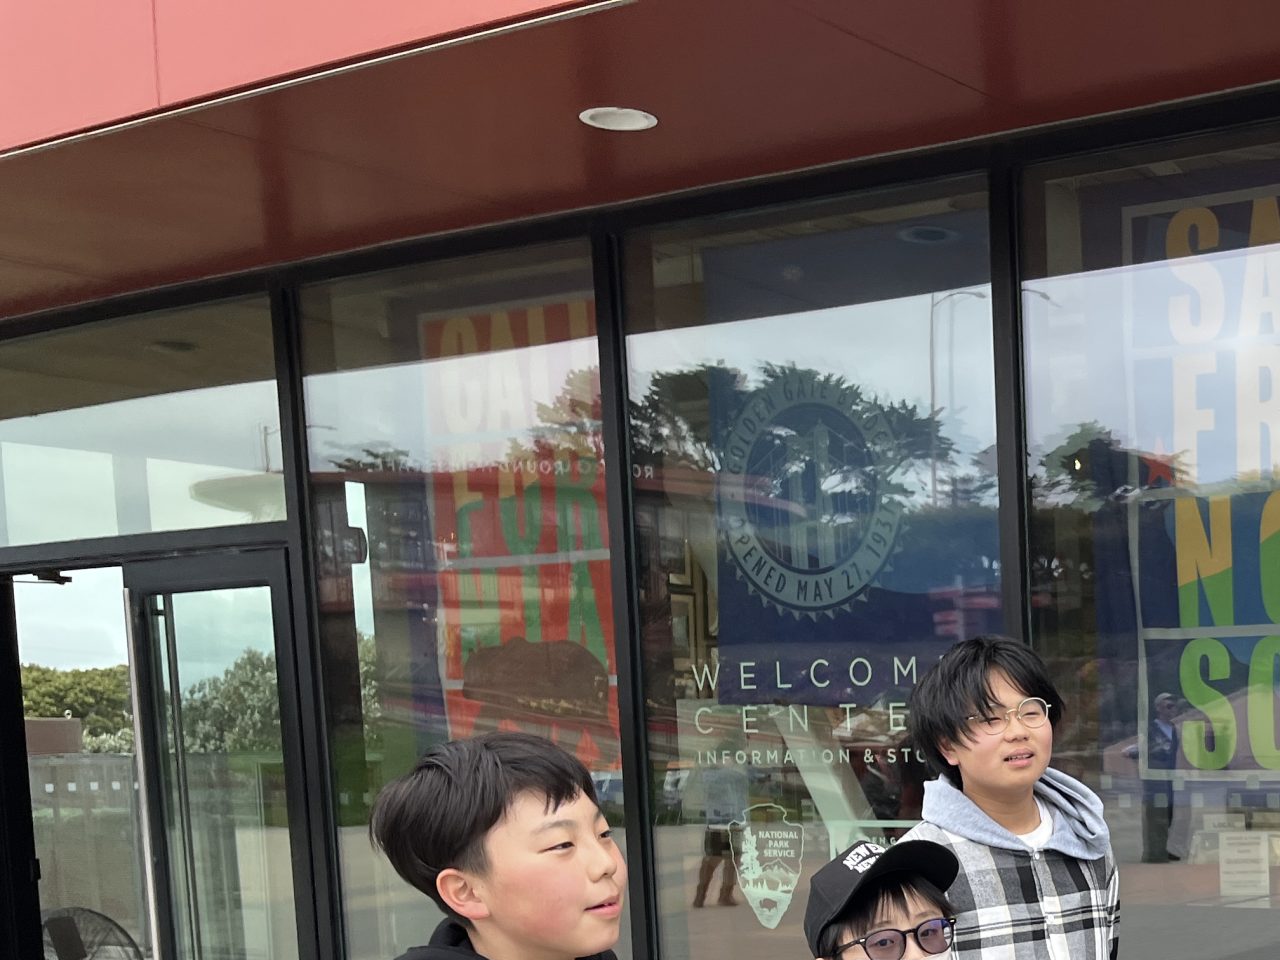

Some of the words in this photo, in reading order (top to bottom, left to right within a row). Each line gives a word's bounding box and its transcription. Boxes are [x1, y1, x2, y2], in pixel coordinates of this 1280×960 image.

[729, 393, 777, 475] GOLDEN
[783, 378, 829, 401] GATE
[797, 579, 834, 603] MAY
[866, 504, 898, 558] 1937
[691, 654, 920, 691] WELCOM
[694, 702, 907, 735] CENTE
[697, 747, 850, 765] INFORMATION
[864, 747, 875, 764] &
[758, 831, 799, 840] NATIONAL
[768, 840, 790, 848] PARK
[764, 849, 796, 858] SERVICE
[843, 843, 870, 870] NEW
